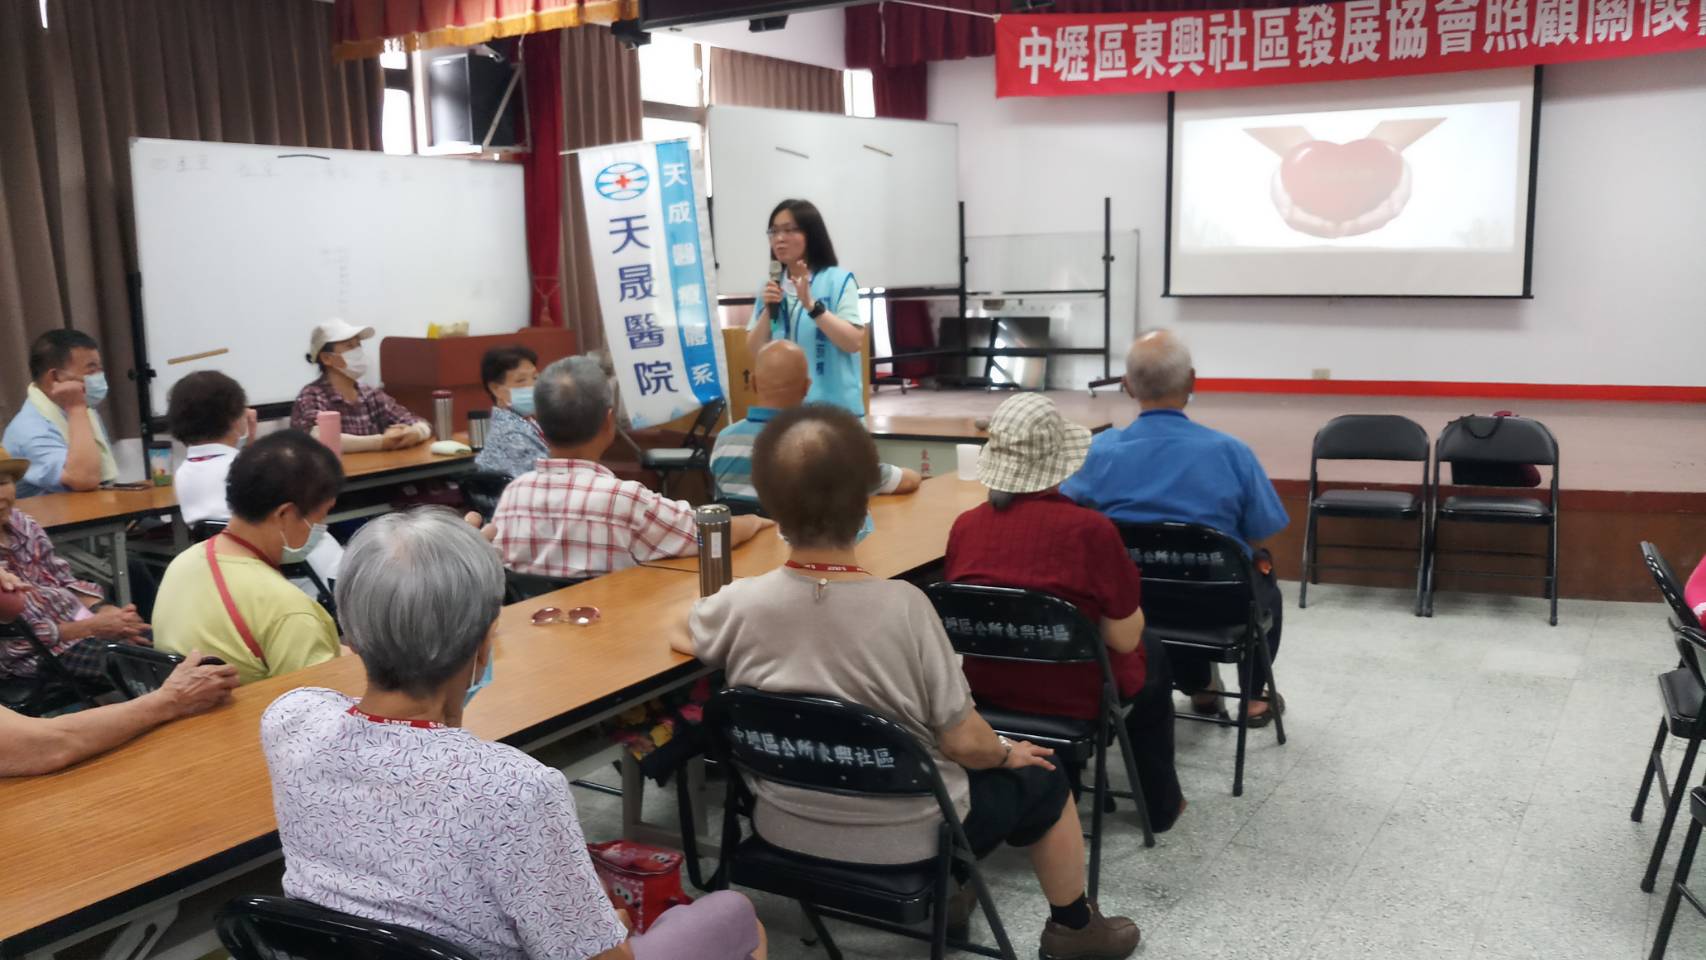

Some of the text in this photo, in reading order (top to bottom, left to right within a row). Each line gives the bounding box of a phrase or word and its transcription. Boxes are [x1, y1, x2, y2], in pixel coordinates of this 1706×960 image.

[1018, 0, 1706, 85] 中壢區東興社區發展協會照顧關懷
[608, 214, 679, 396] 天晟醫院
[732, 725, 896, 769] 中壢區公所東興社區
